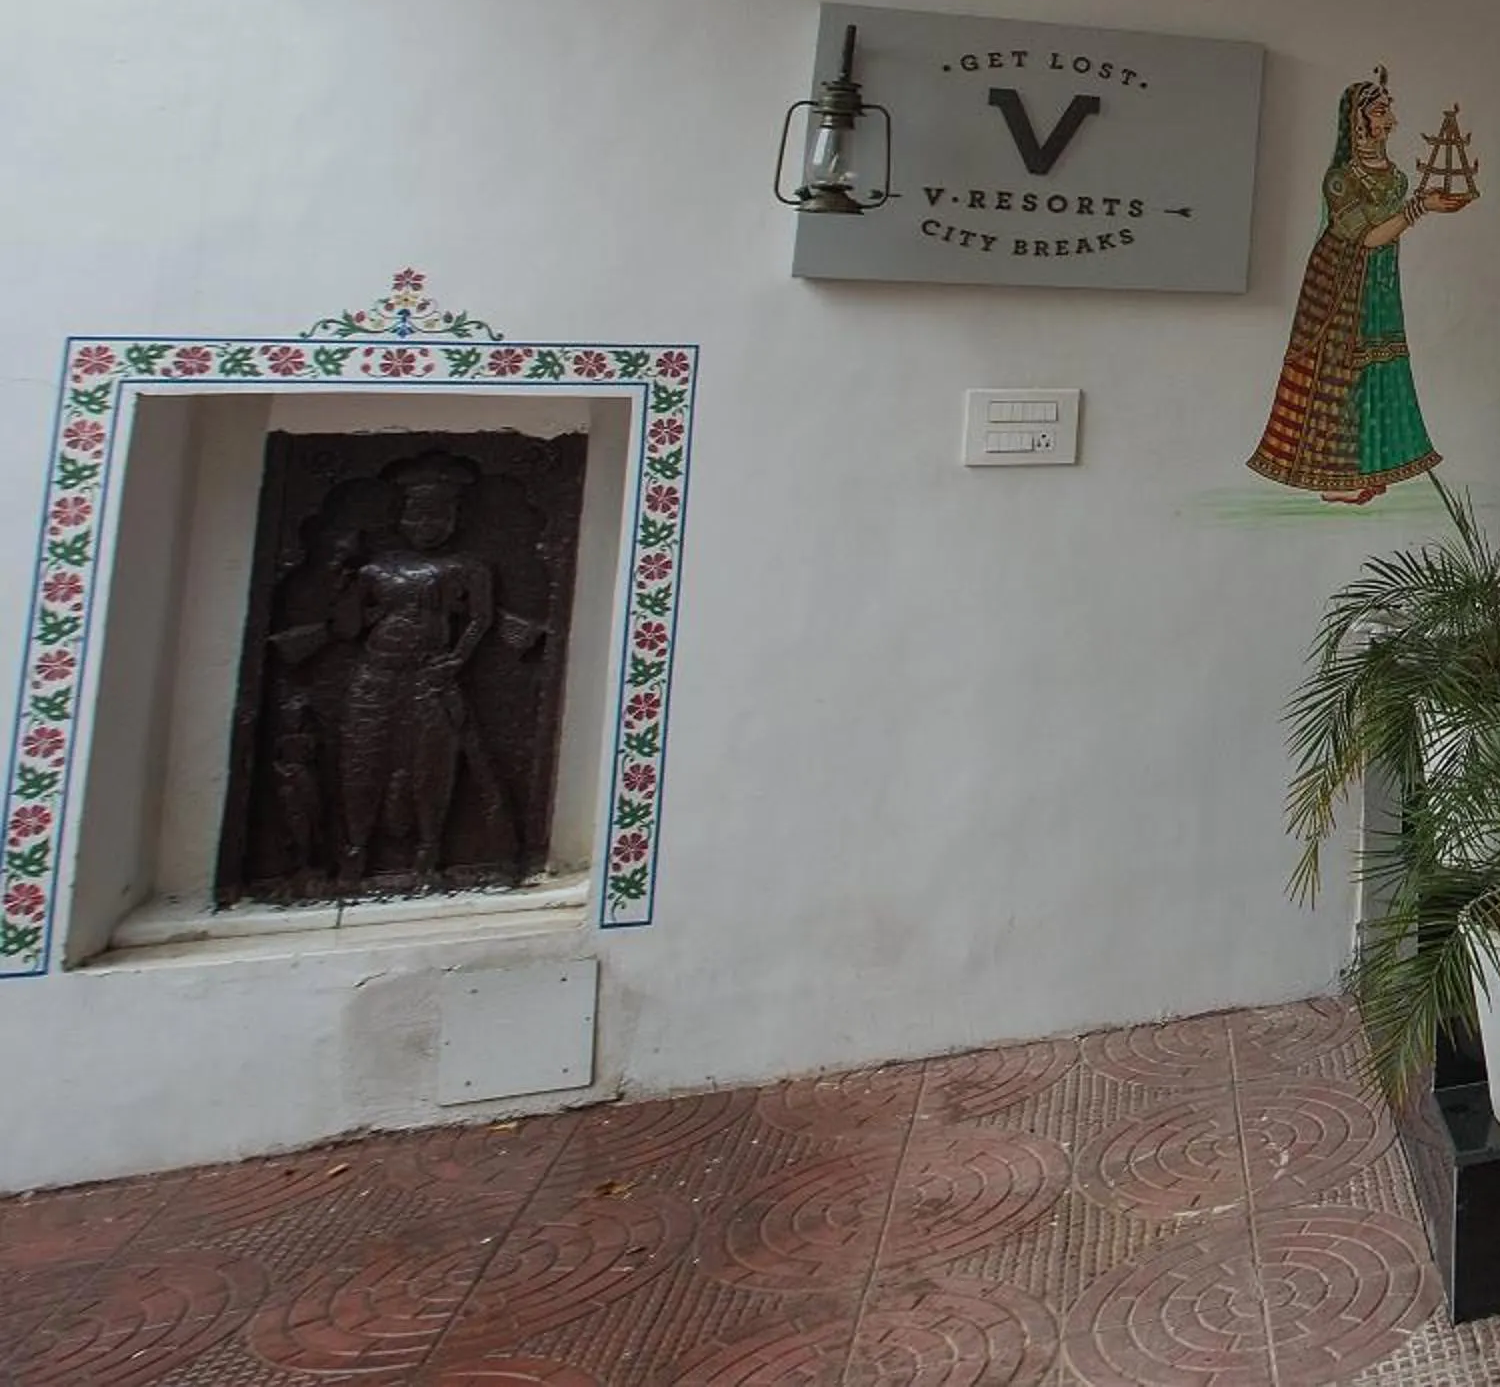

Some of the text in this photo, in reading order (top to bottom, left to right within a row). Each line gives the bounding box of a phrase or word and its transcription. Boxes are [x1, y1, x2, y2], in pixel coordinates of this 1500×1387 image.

[987, 86, 1102, 177] V
[920, 218, 1136, 258] CITY BREAKS
